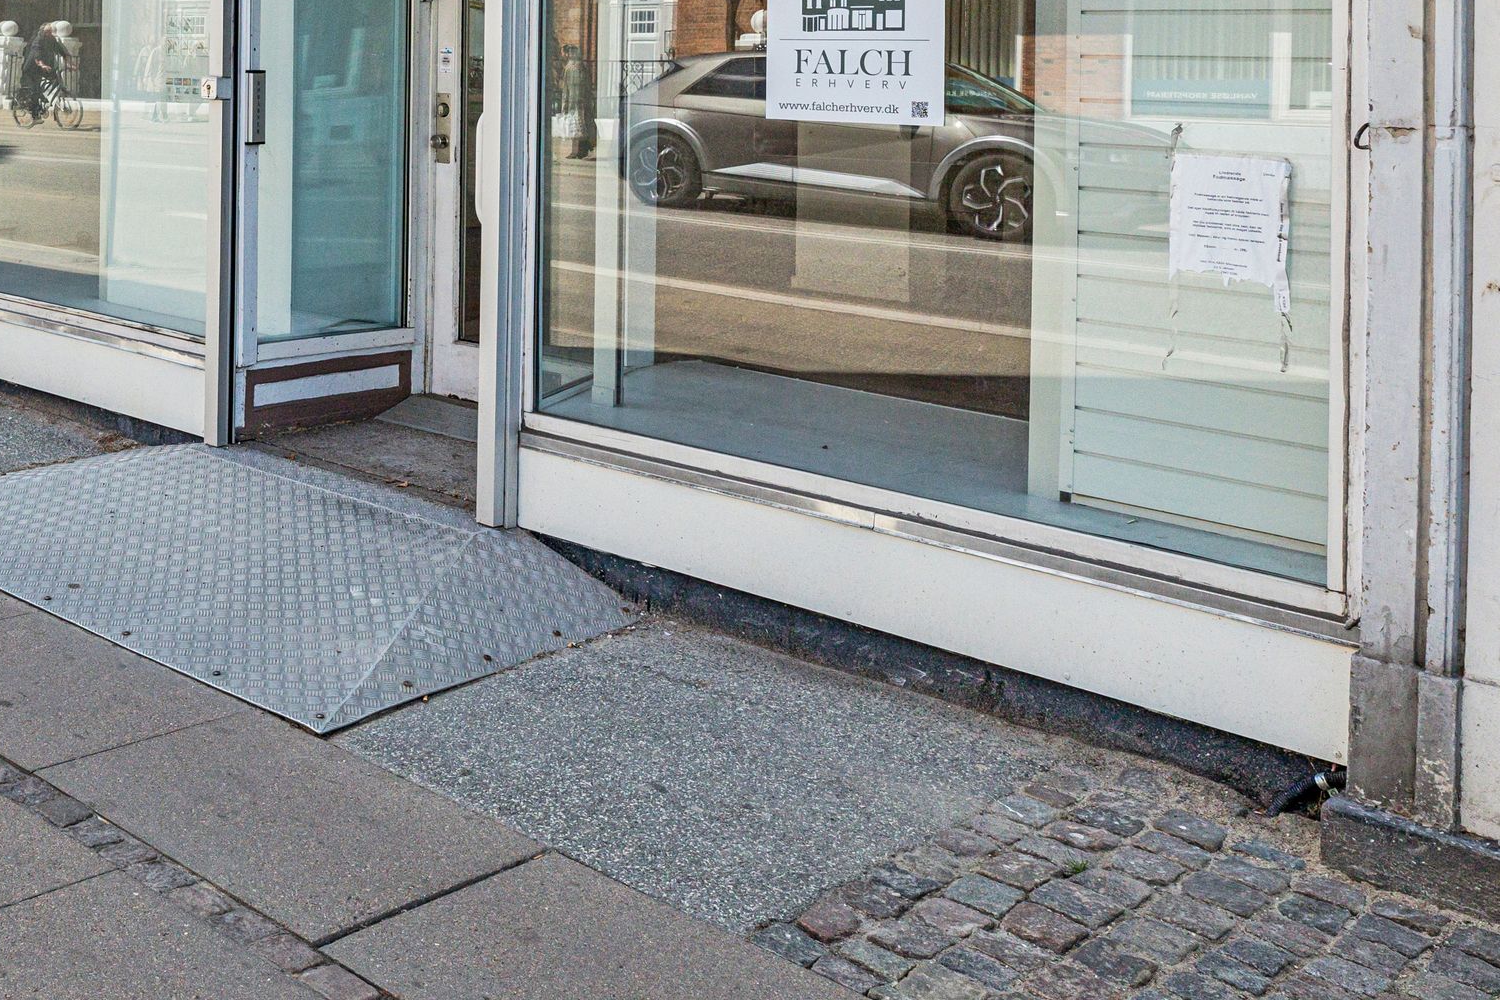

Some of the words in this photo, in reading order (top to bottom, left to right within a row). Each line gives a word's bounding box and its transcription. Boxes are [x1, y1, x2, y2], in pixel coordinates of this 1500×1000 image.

[794, 49, 913, 76] FALCH
[795, 78, 907, 90] ERHVERV
[778, 101, 900, 114] www.falcherhverv.dk
